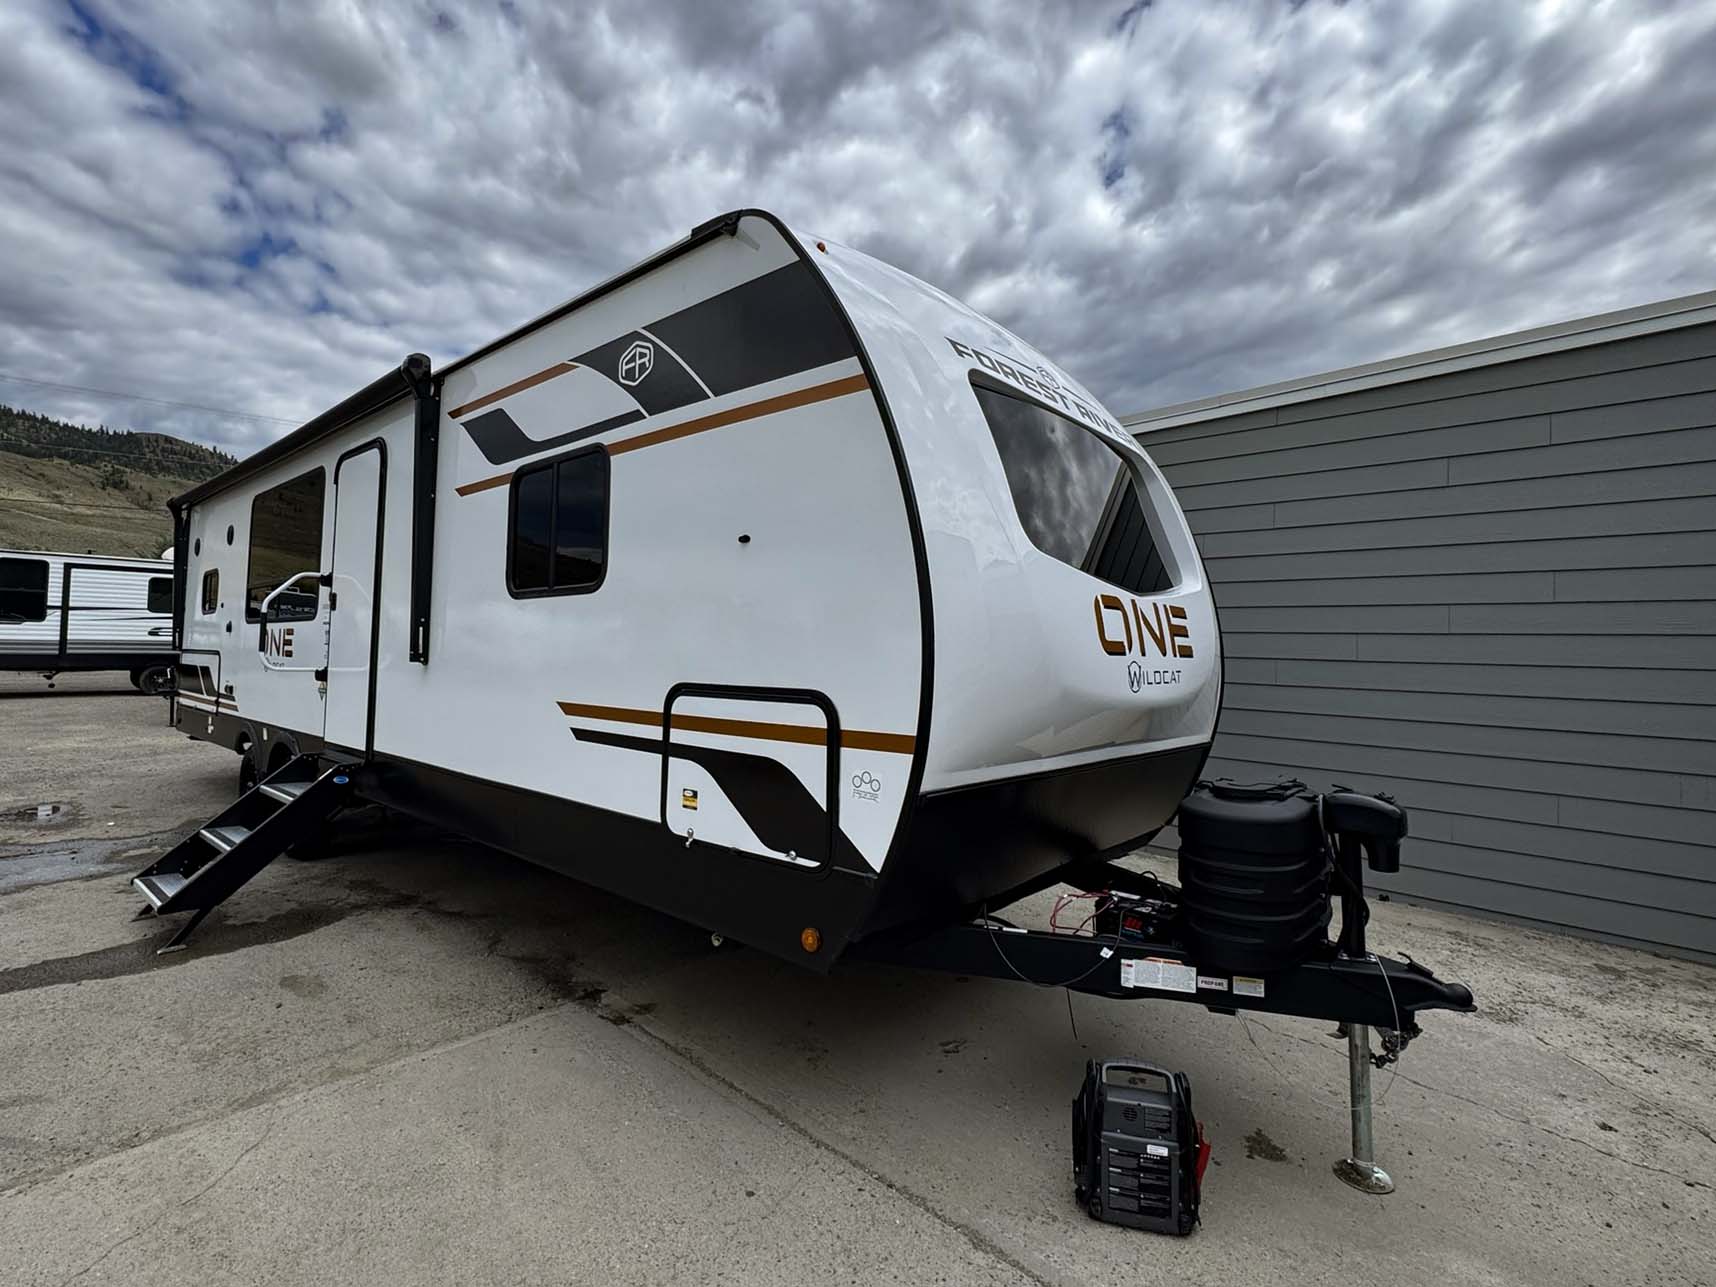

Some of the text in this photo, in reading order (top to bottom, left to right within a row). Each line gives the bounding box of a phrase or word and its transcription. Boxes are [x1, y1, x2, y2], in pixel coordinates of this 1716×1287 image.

[944, 336, 1071, 410] FOREST
[1094, 594, 1194, 659] ONE
[1128, 661, 1182, 693] WILDCAT
